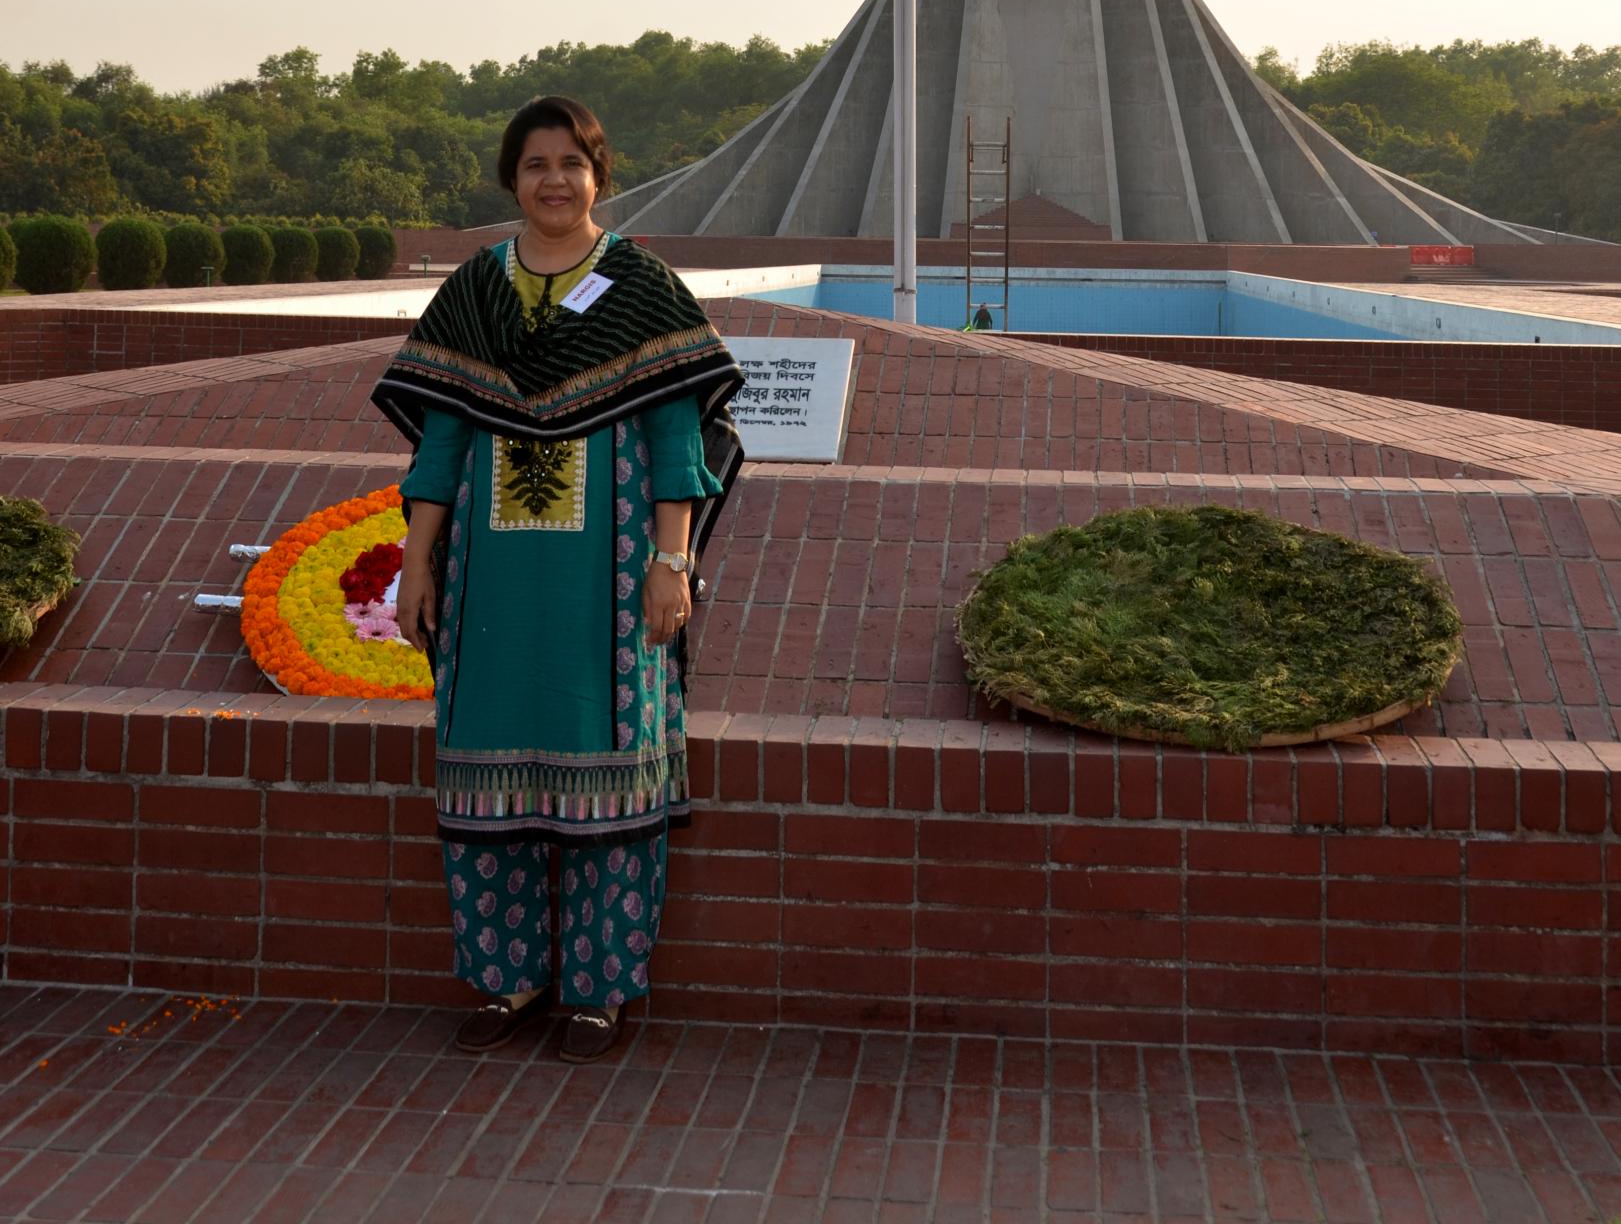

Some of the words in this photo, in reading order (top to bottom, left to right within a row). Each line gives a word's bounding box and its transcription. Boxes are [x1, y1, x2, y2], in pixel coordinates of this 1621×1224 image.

[769, 359, 816, 369] শহীদের
[776, 370, 815, 381] দিবসে
[773, 387, 811, 403] রহমান
